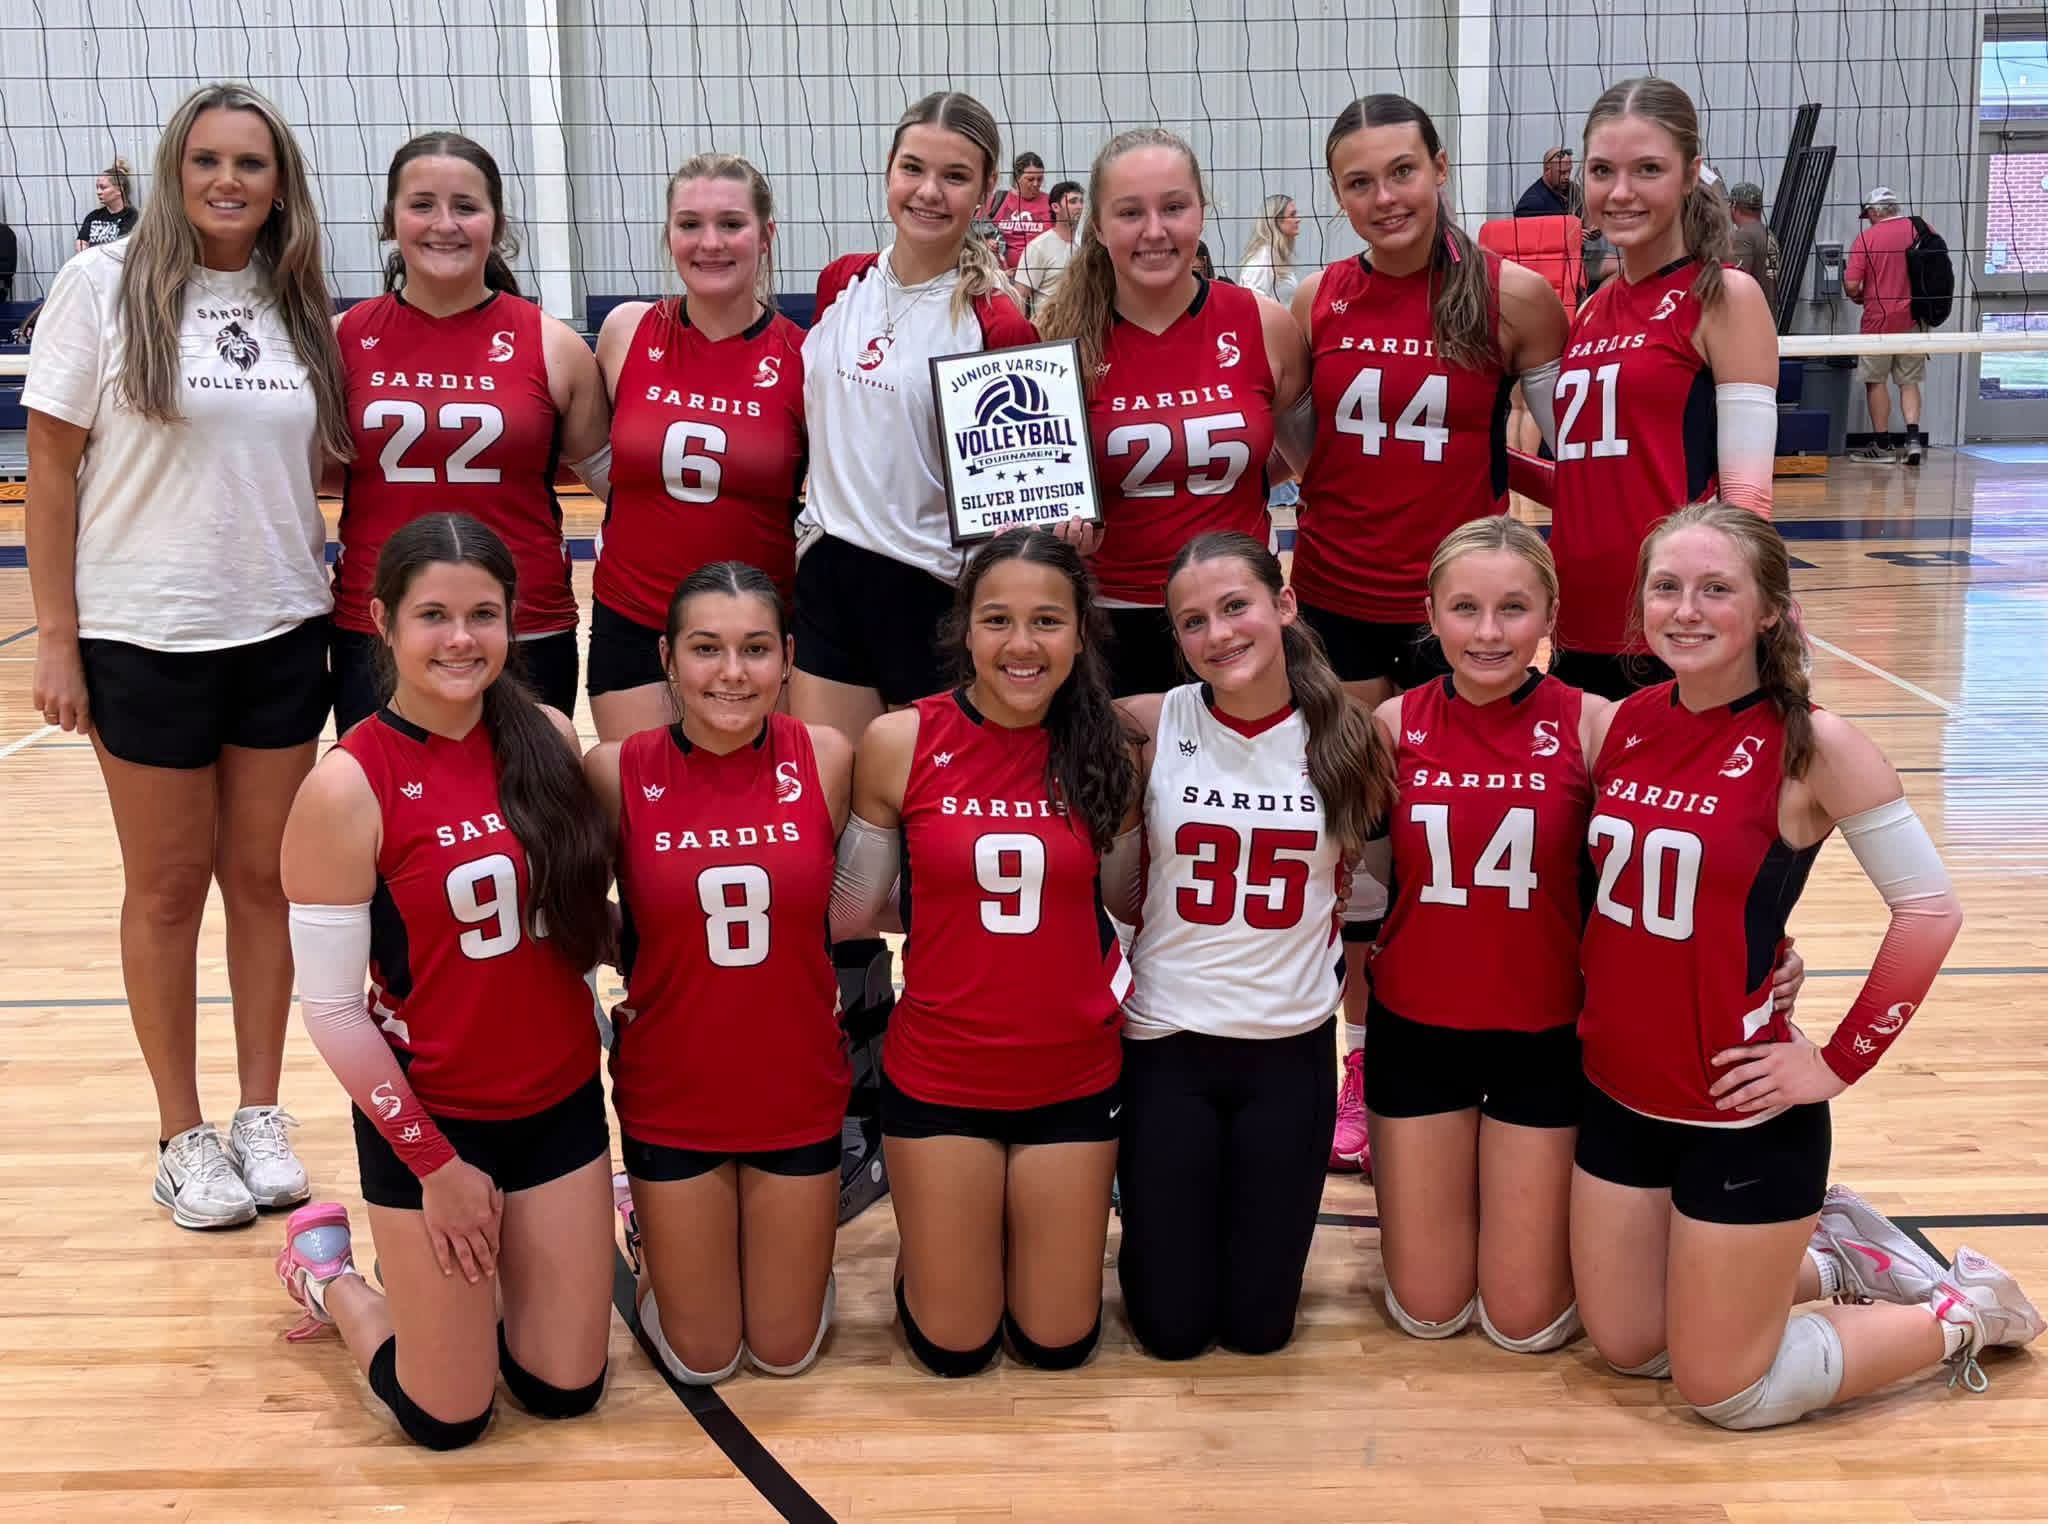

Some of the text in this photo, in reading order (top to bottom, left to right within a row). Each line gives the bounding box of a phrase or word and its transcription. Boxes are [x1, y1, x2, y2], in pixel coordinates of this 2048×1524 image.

[196, 307, 255, 321] SARDIS
[1339, 336, 1450, 358] SARDI
[1568, 333, 1647, 359] SARDIS
[187, 376, 300, 391] VOLLEYBALL
[370, 371, 496, 391] SARDIS
[952, 358, 1069, 393] JUNIOR VARSITY
[646, 385, 762, 417] SARDIS
[1111, 384, 1234, 412] SARDIS
[1334, 366, 1450, 463] 44
[1554, 363, 1630, 462] 21
[362, 399, 505, 484] 22
[955, 418, 1078, 460] VOLLEYBALL
[1107, 411, 1250, 498] 25
[661, 420, 728, 504] 6
[978, 449, 1060, 466] TOURNAMENT
[961, 481, 1086, 511] SILVER DIVISION
[982, 503, 1069, 527] CHAMPIONS
[1413, 769, 1546, 791] SARDIS
[1607, 778, 1719, 815] SARDIS
[1182, 786, 1316, 813] SARDIS
[655, 822, 801, 852] SARDIS
[1409, 803, 1539, 910] 14
[973, 832, 1047, 935] 9
[1175, 821, 1318, 930] 35
[1588, 814, 1704, 941] 20
[696, 863, 773, 969] 8
